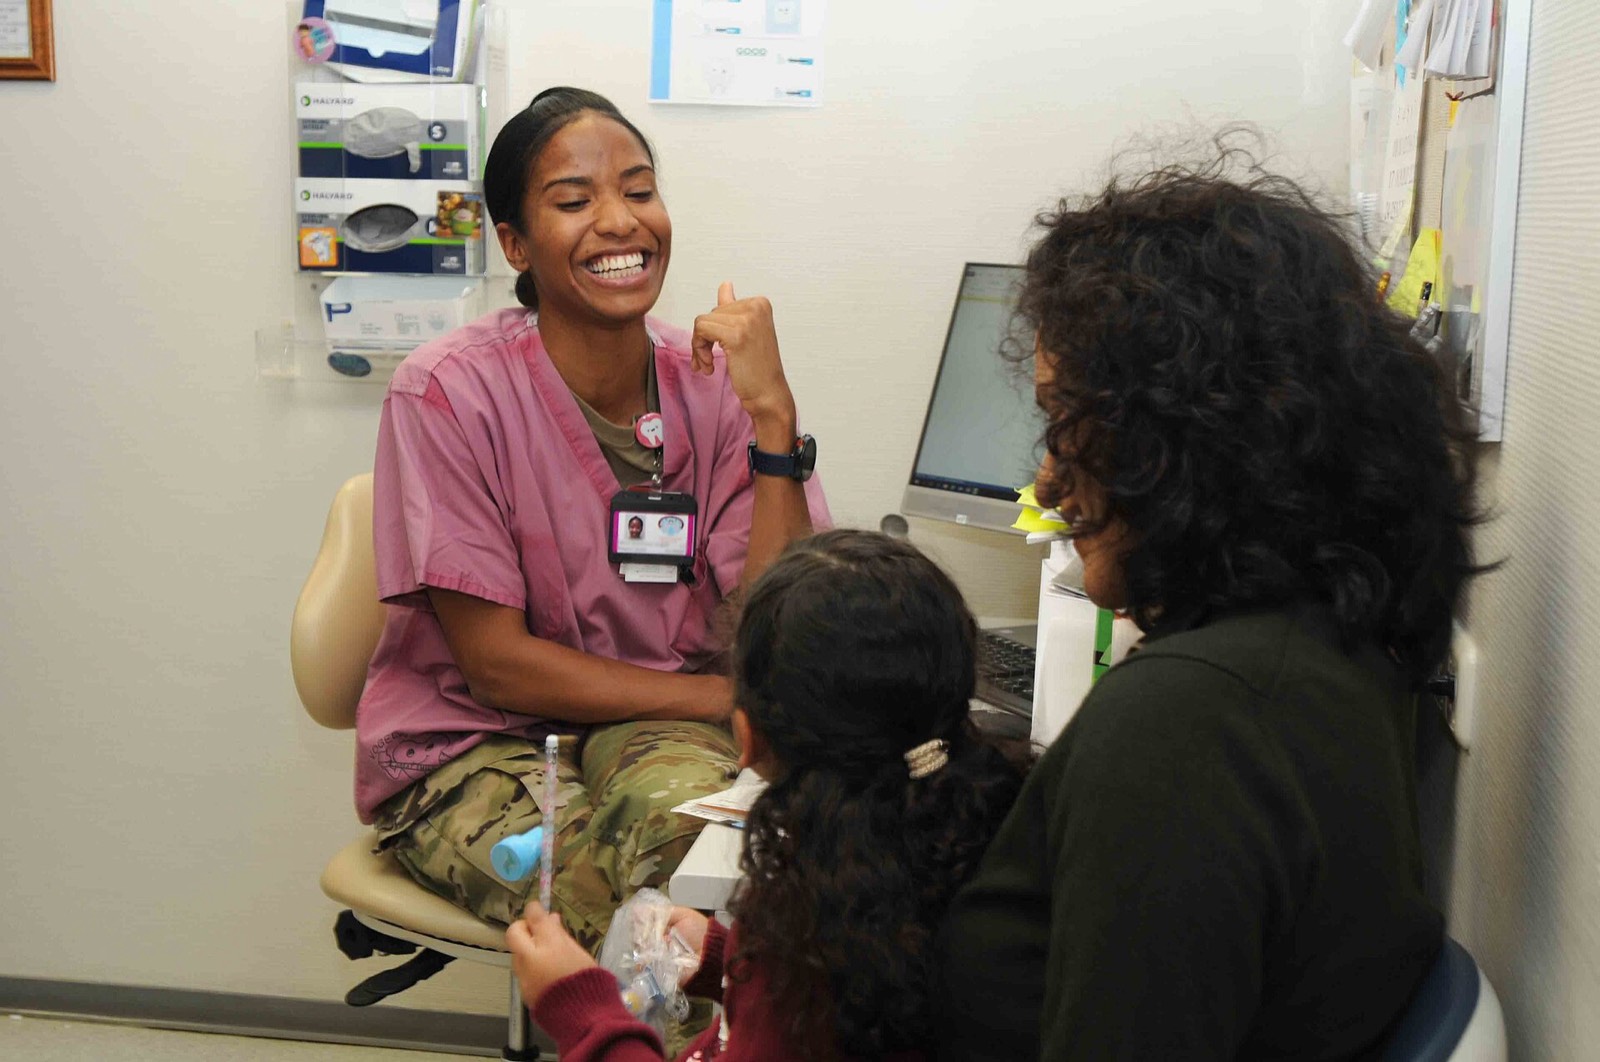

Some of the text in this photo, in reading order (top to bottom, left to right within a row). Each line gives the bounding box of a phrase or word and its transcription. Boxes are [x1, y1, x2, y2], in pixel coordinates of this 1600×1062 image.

[735, 47, 768, 57] GOOD
[312, 97, 354, 105] HALYARD
[431, 125, 442, 139] S
[312, 191, 353, 200] HALYARD
